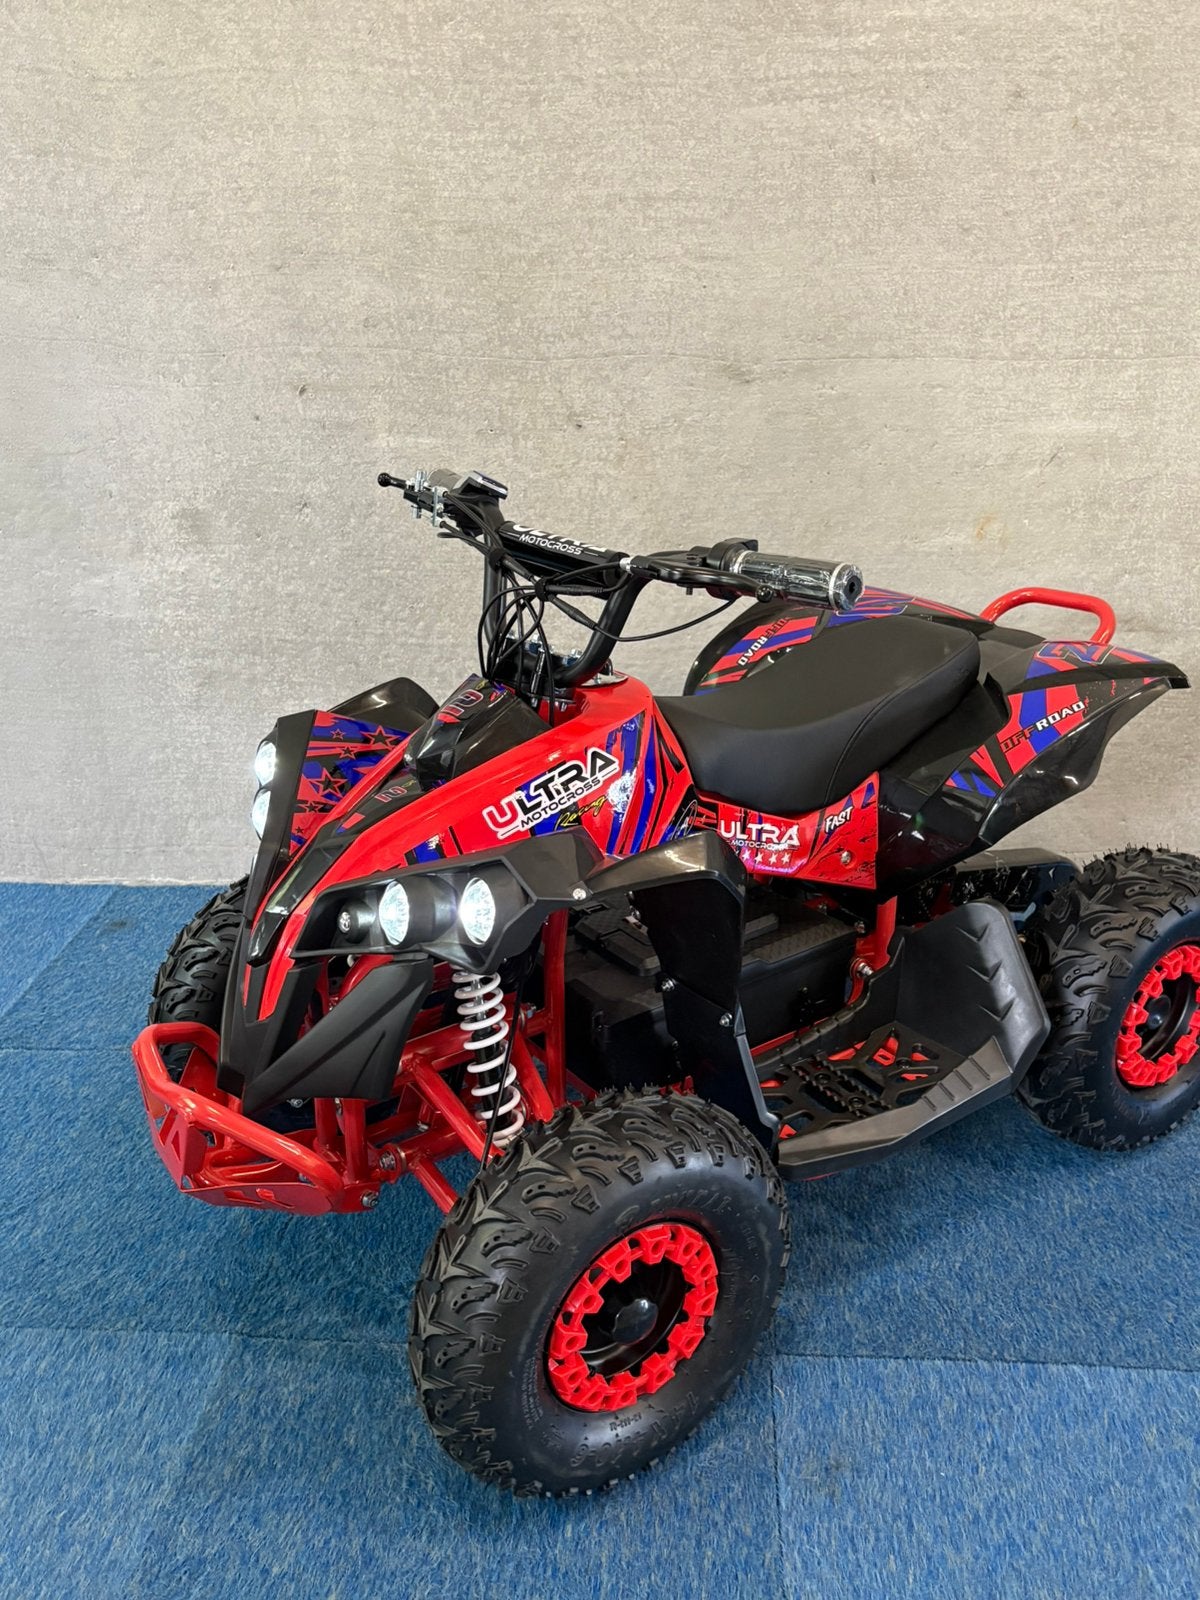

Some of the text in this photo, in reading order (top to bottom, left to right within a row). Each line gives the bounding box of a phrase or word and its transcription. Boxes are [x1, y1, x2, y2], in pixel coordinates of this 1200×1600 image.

[518, 533, 583, 556] MOTOCROSS
[483, 748, 618, 832] ULTRA
[520, 776, 602, 829] MOTOCROSS
[720, 819, 800, 847] ULTRA
[824, 806, 853, 834] FAST
